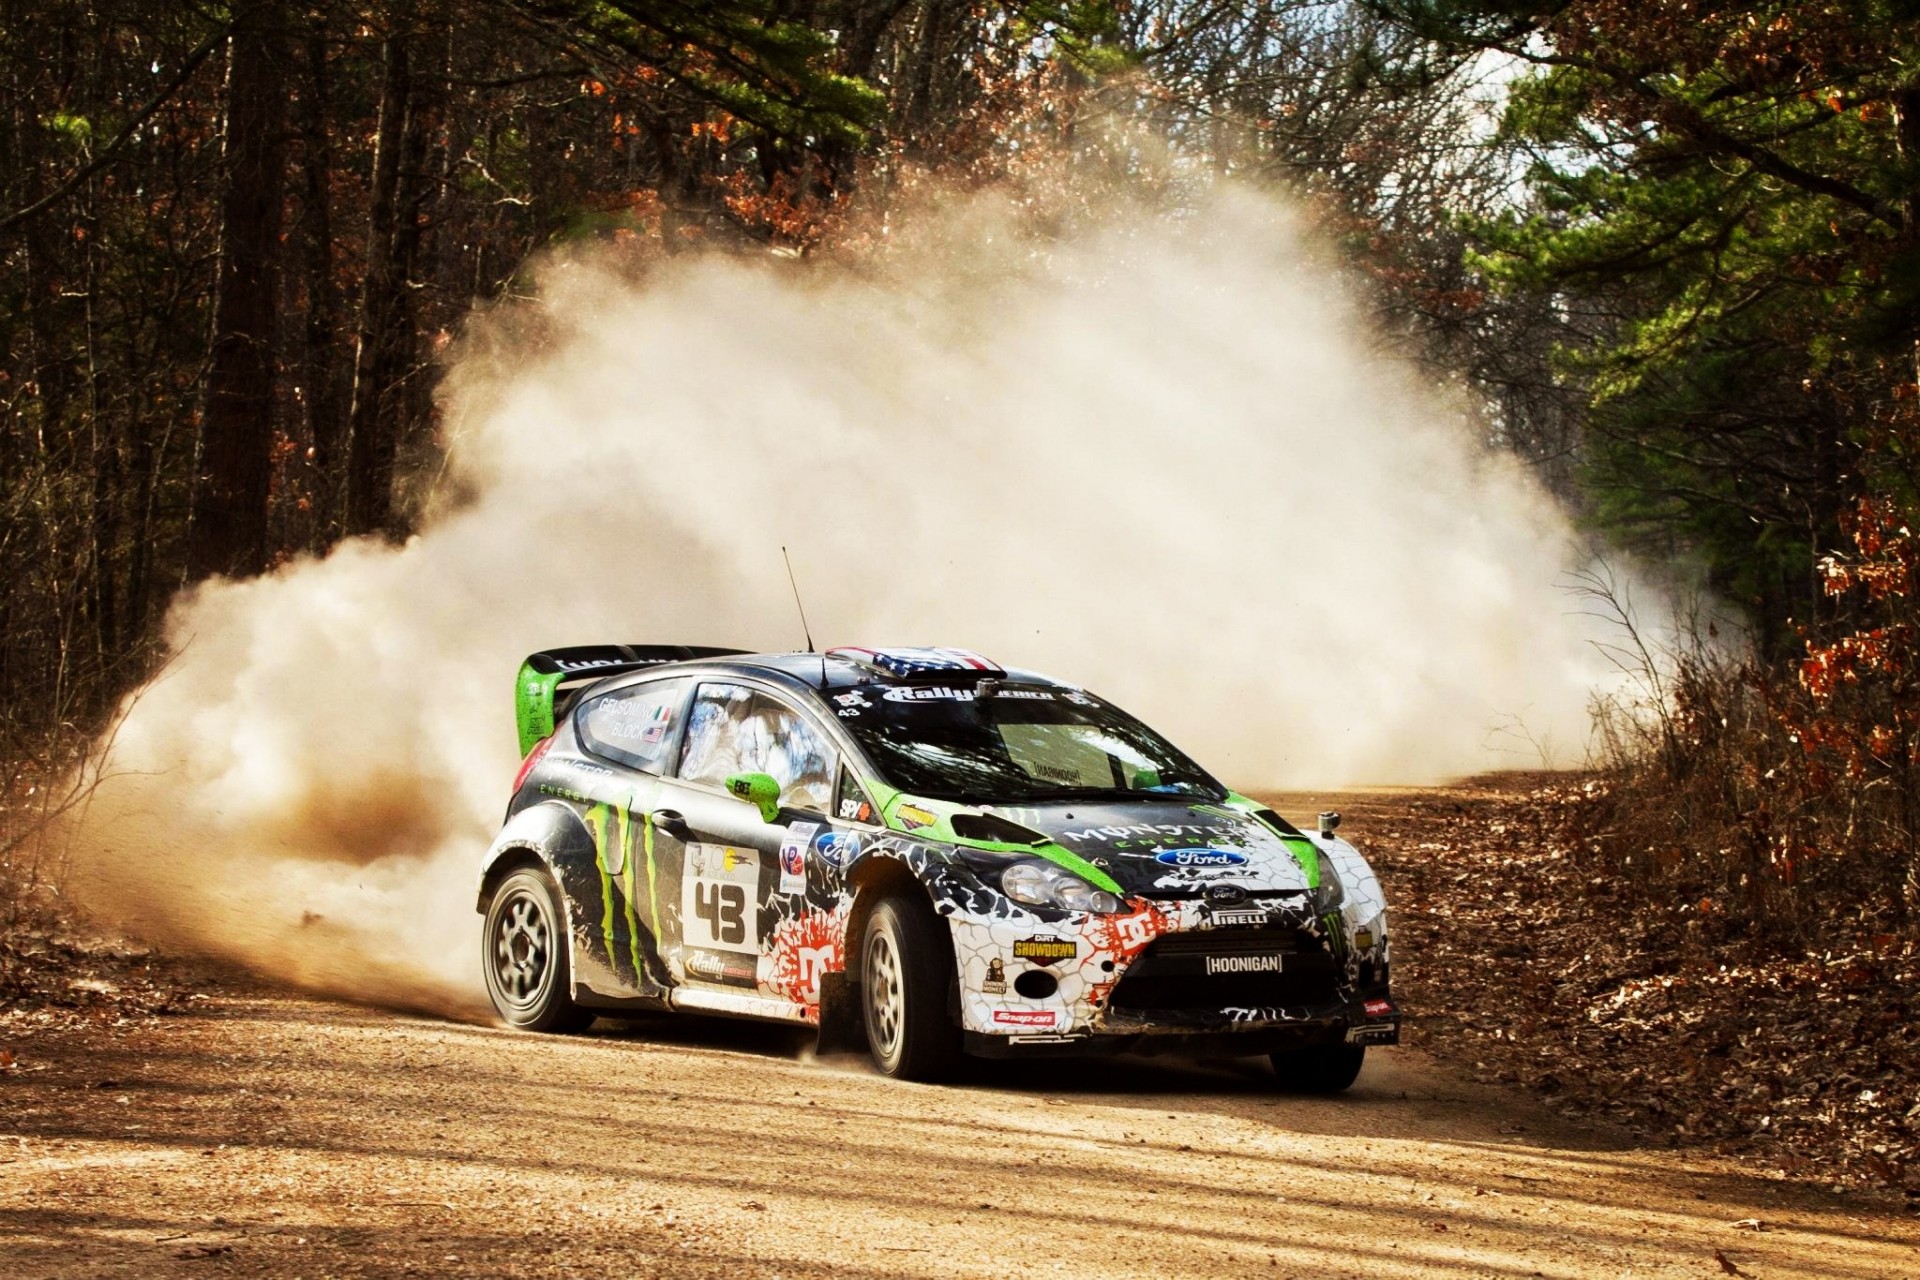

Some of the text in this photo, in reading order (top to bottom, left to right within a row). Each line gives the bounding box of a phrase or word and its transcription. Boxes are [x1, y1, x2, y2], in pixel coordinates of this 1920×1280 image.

[882, 686, 976, 702] Rally
[838, 708, 861, 717] 43
[613, 722, 646, 740] BLOCK
[540, 783, 589, 802] ENERGY
[1114, 836, 1247, 849] ENERGY
[1175, 850, 1232, 866] Ford
[1213, 886, 1238, 899] Ford
[695, 881, 745, 944] 43
[1211, 909, 1268, 925] PIRELLI
[1014, 942, 1076, 958] SHOWDOWN
[996, 1012, 1053, 1024] Snap-on
